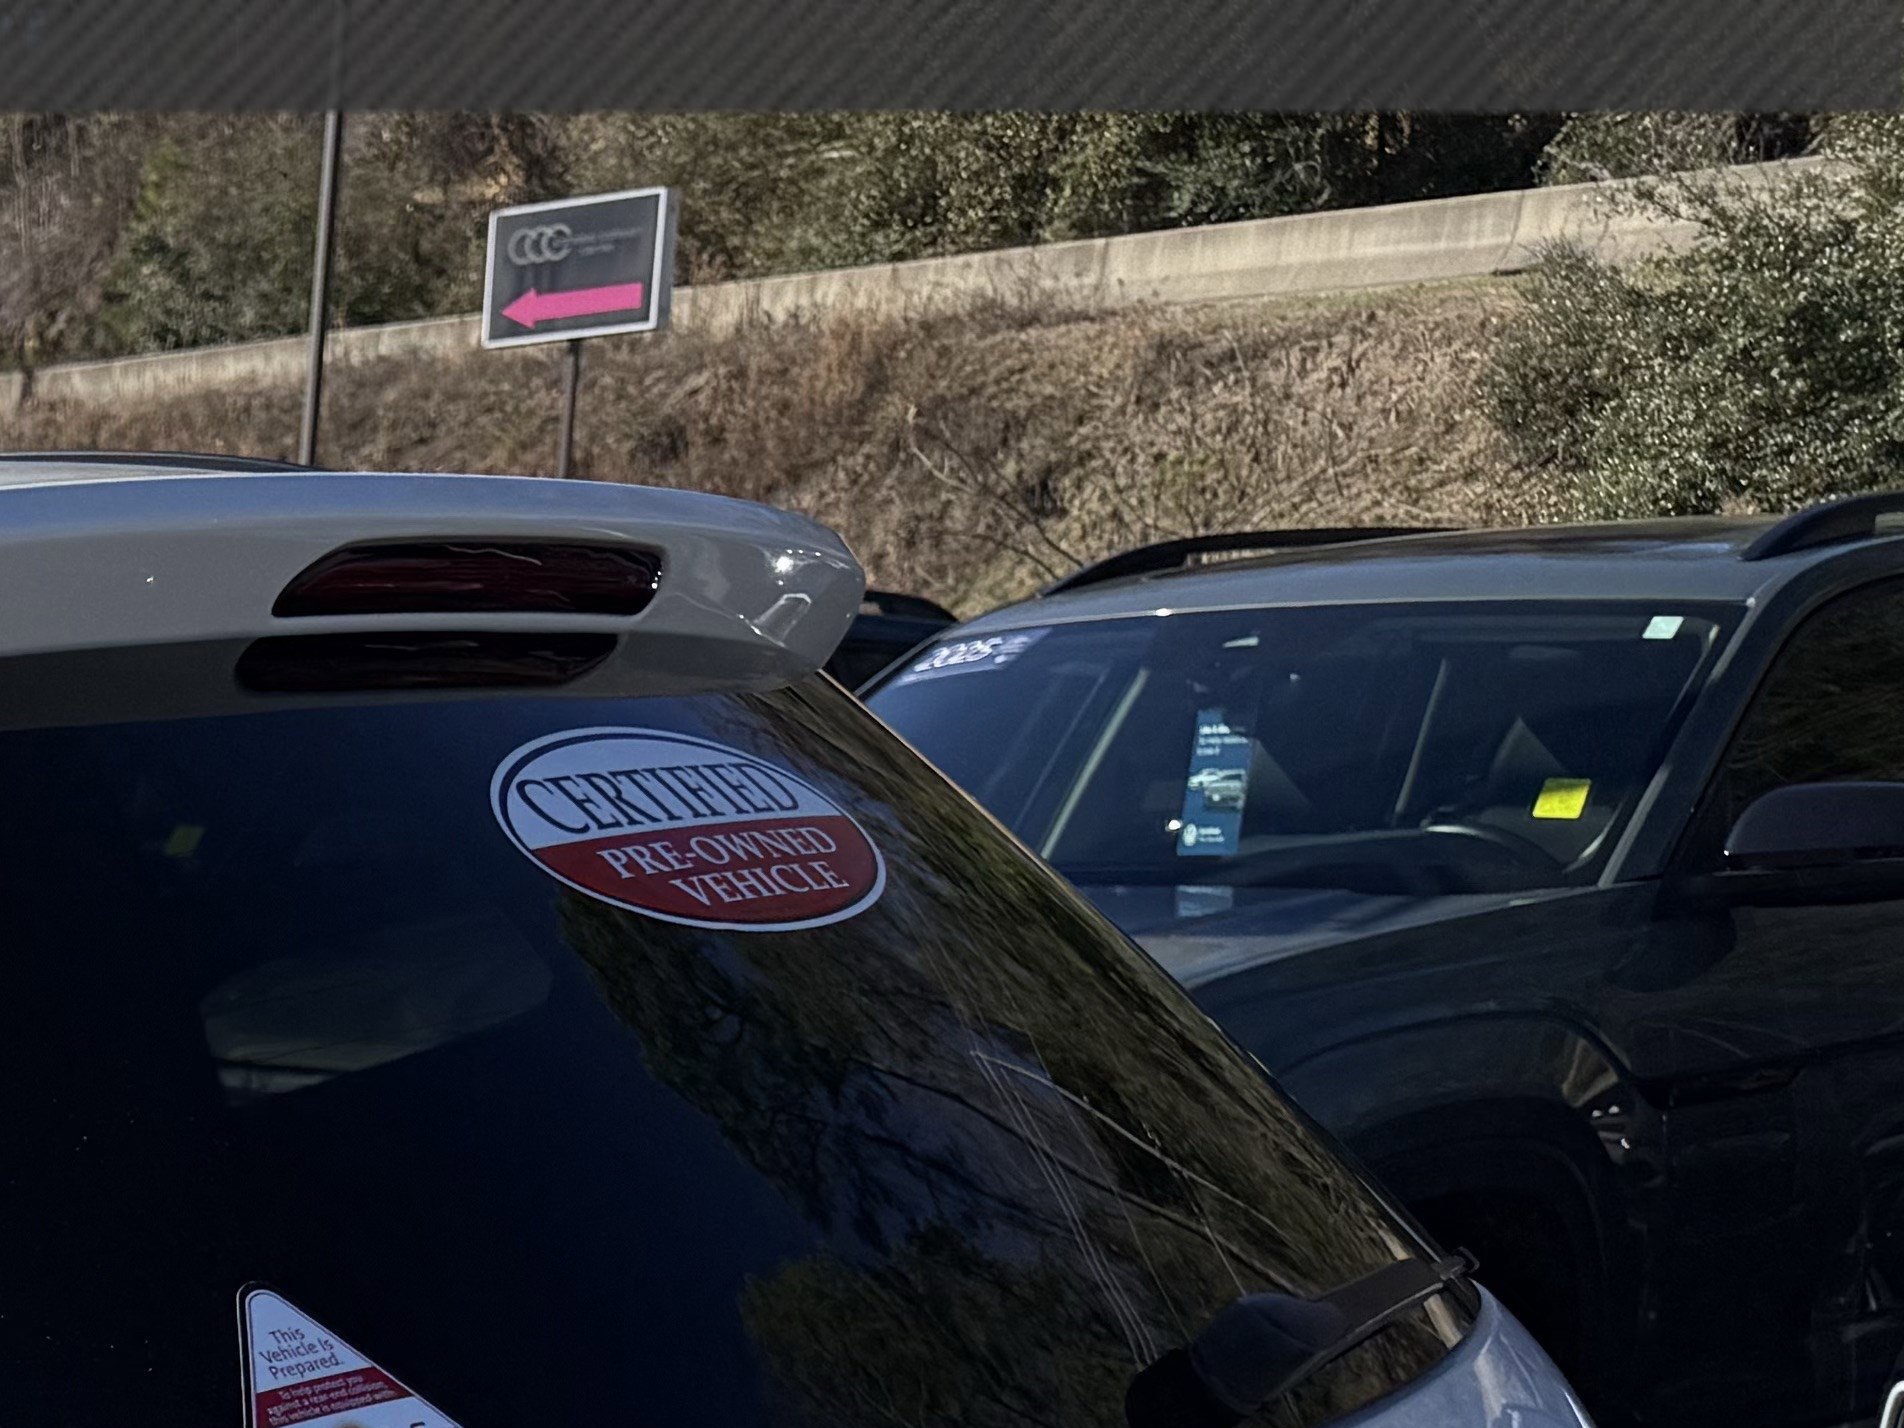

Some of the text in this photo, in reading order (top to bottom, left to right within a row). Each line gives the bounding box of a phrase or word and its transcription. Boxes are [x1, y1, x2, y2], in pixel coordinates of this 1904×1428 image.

[516, 762, 799, 834] CERTIFIED
[597, 826, 837, 880] PRE-OWNED
[669, 861, 850, 907] VEHICLE
[259, 1337, 334, 1364] Vehicle Is
[269, 1327, 305, 1344] This
[268, 1352, 344, 1380] Prepared.
